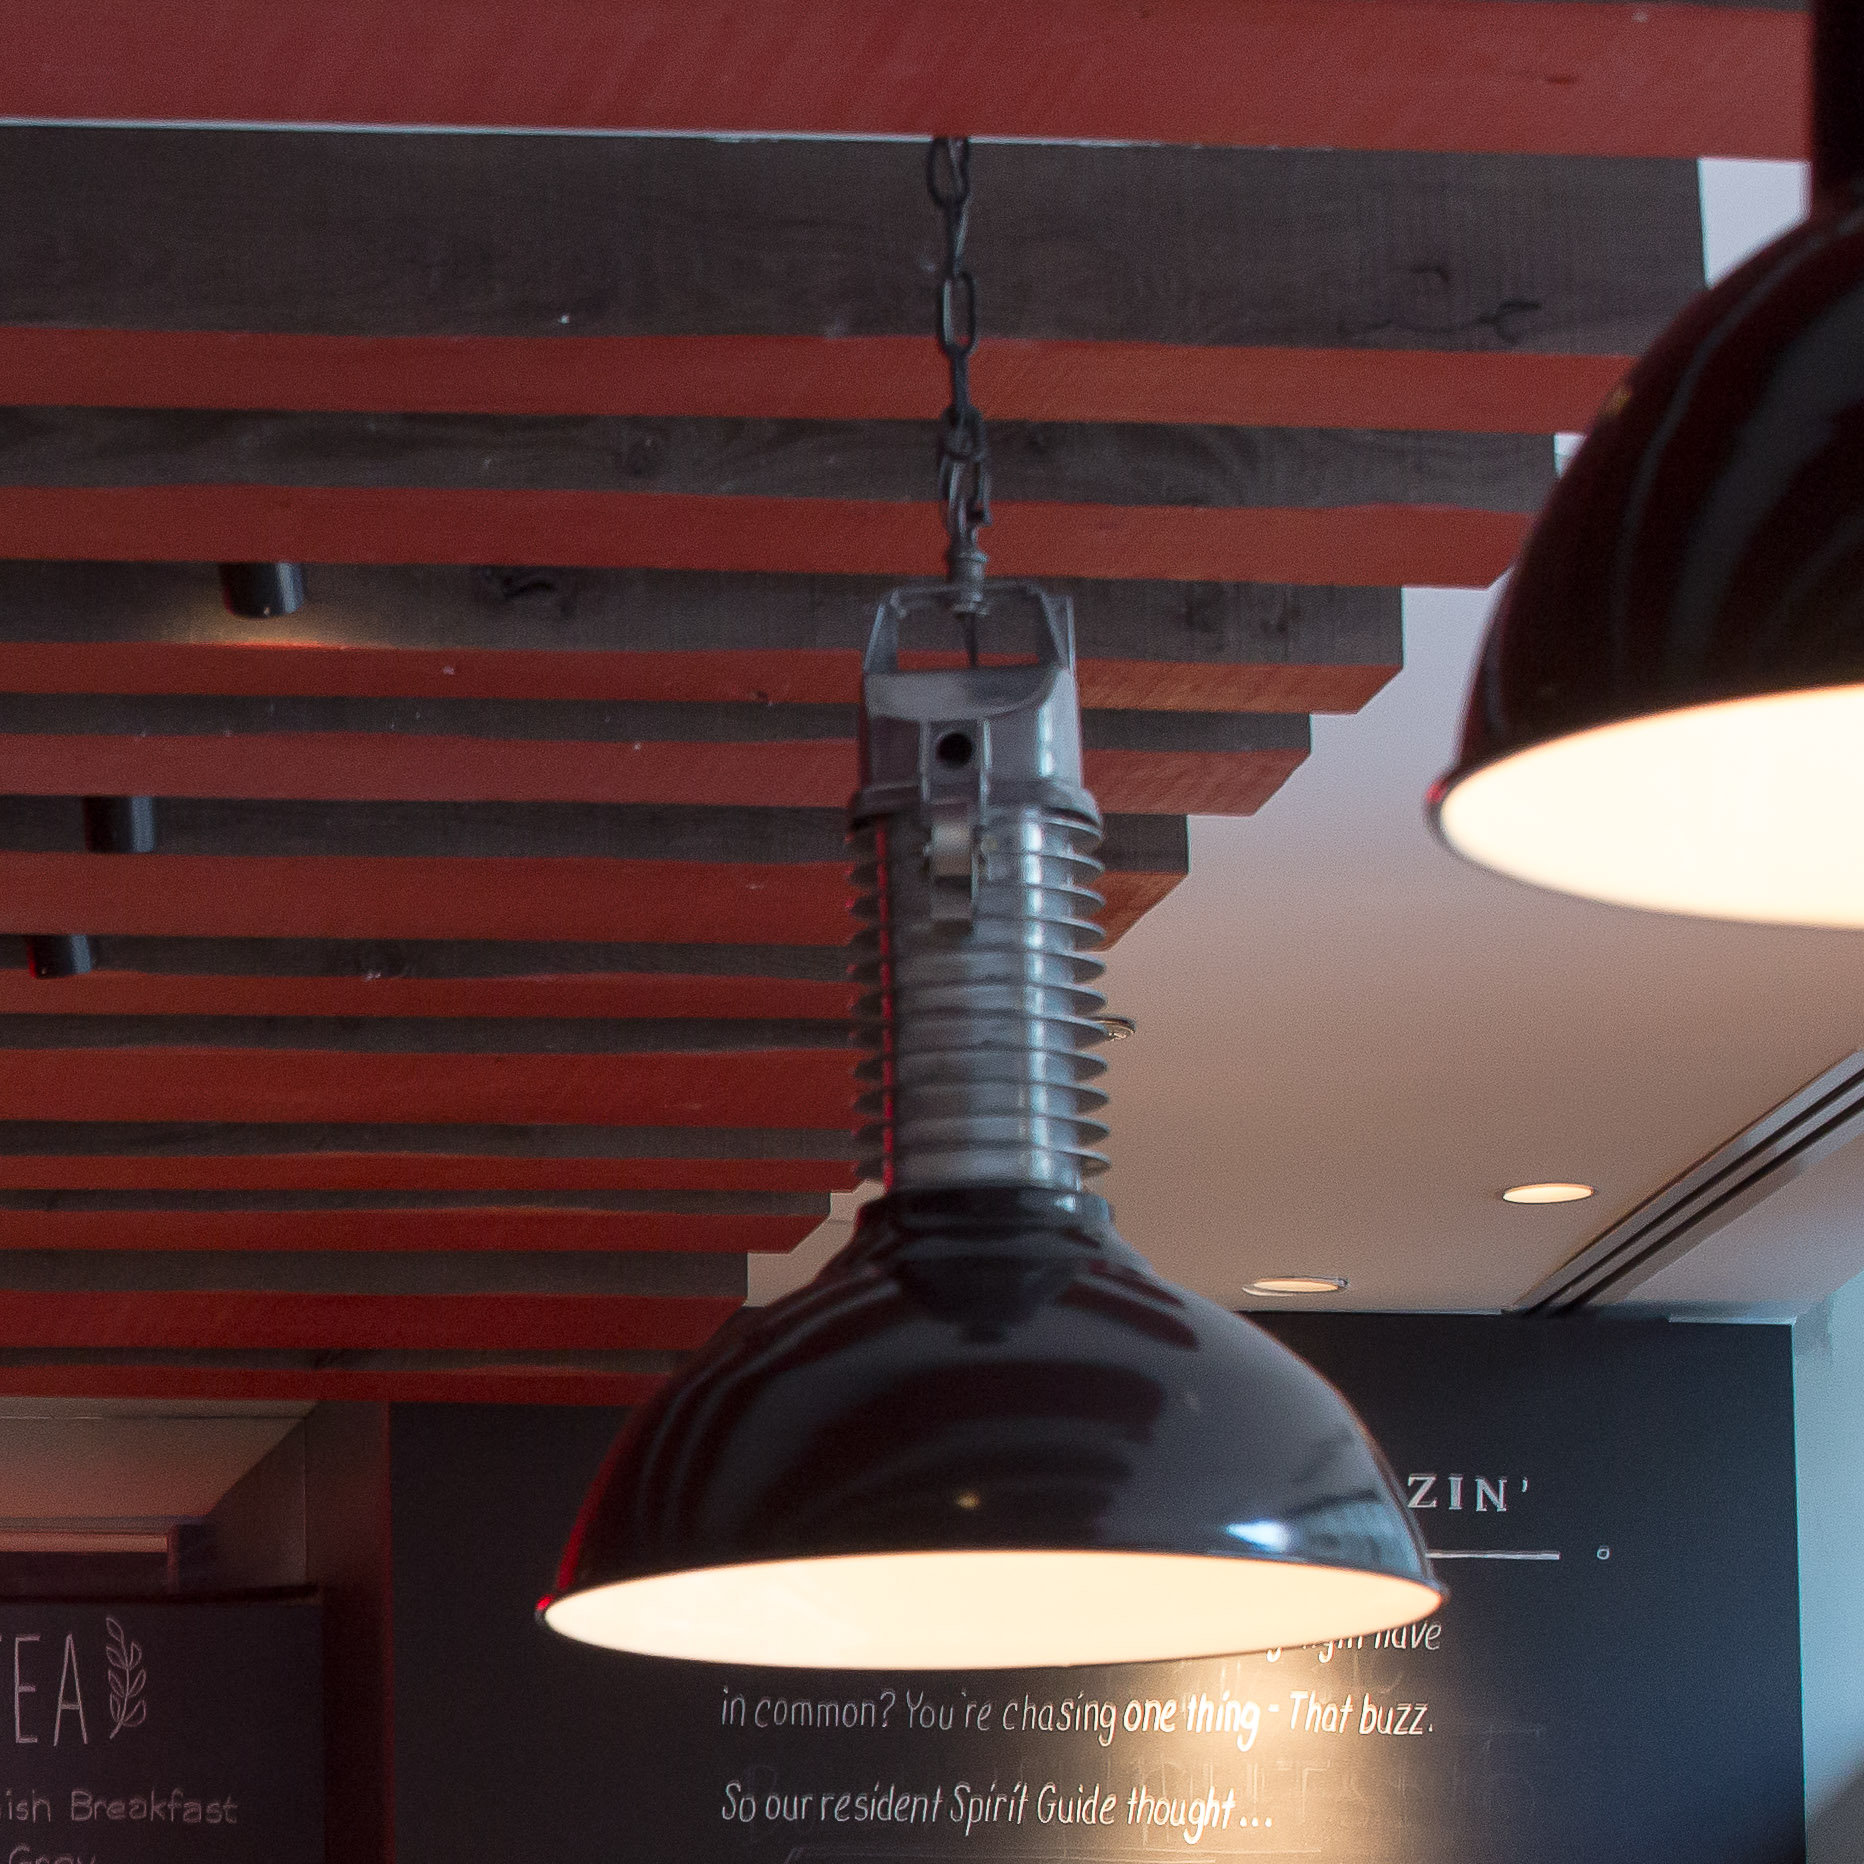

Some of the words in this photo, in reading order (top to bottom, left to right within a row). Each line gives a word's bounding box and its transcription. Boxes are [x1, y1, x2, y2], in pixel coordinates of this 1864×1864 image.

[722, 1687, 746, 1726] in
[754, 1690, 896, 1728] common?
[906, 1691, 992, 1731] You're
[1003, 1693, 1117, 1746] chasing
[1125, 1700, 1174, 1731] one
[1185, 1690, 1262, 1751] thing
[1287, 1689, 1354, 1736] That
[1361, 1694, 1433, 1735] buzz.
[70, 1788, 237, 1824] Breakfast
